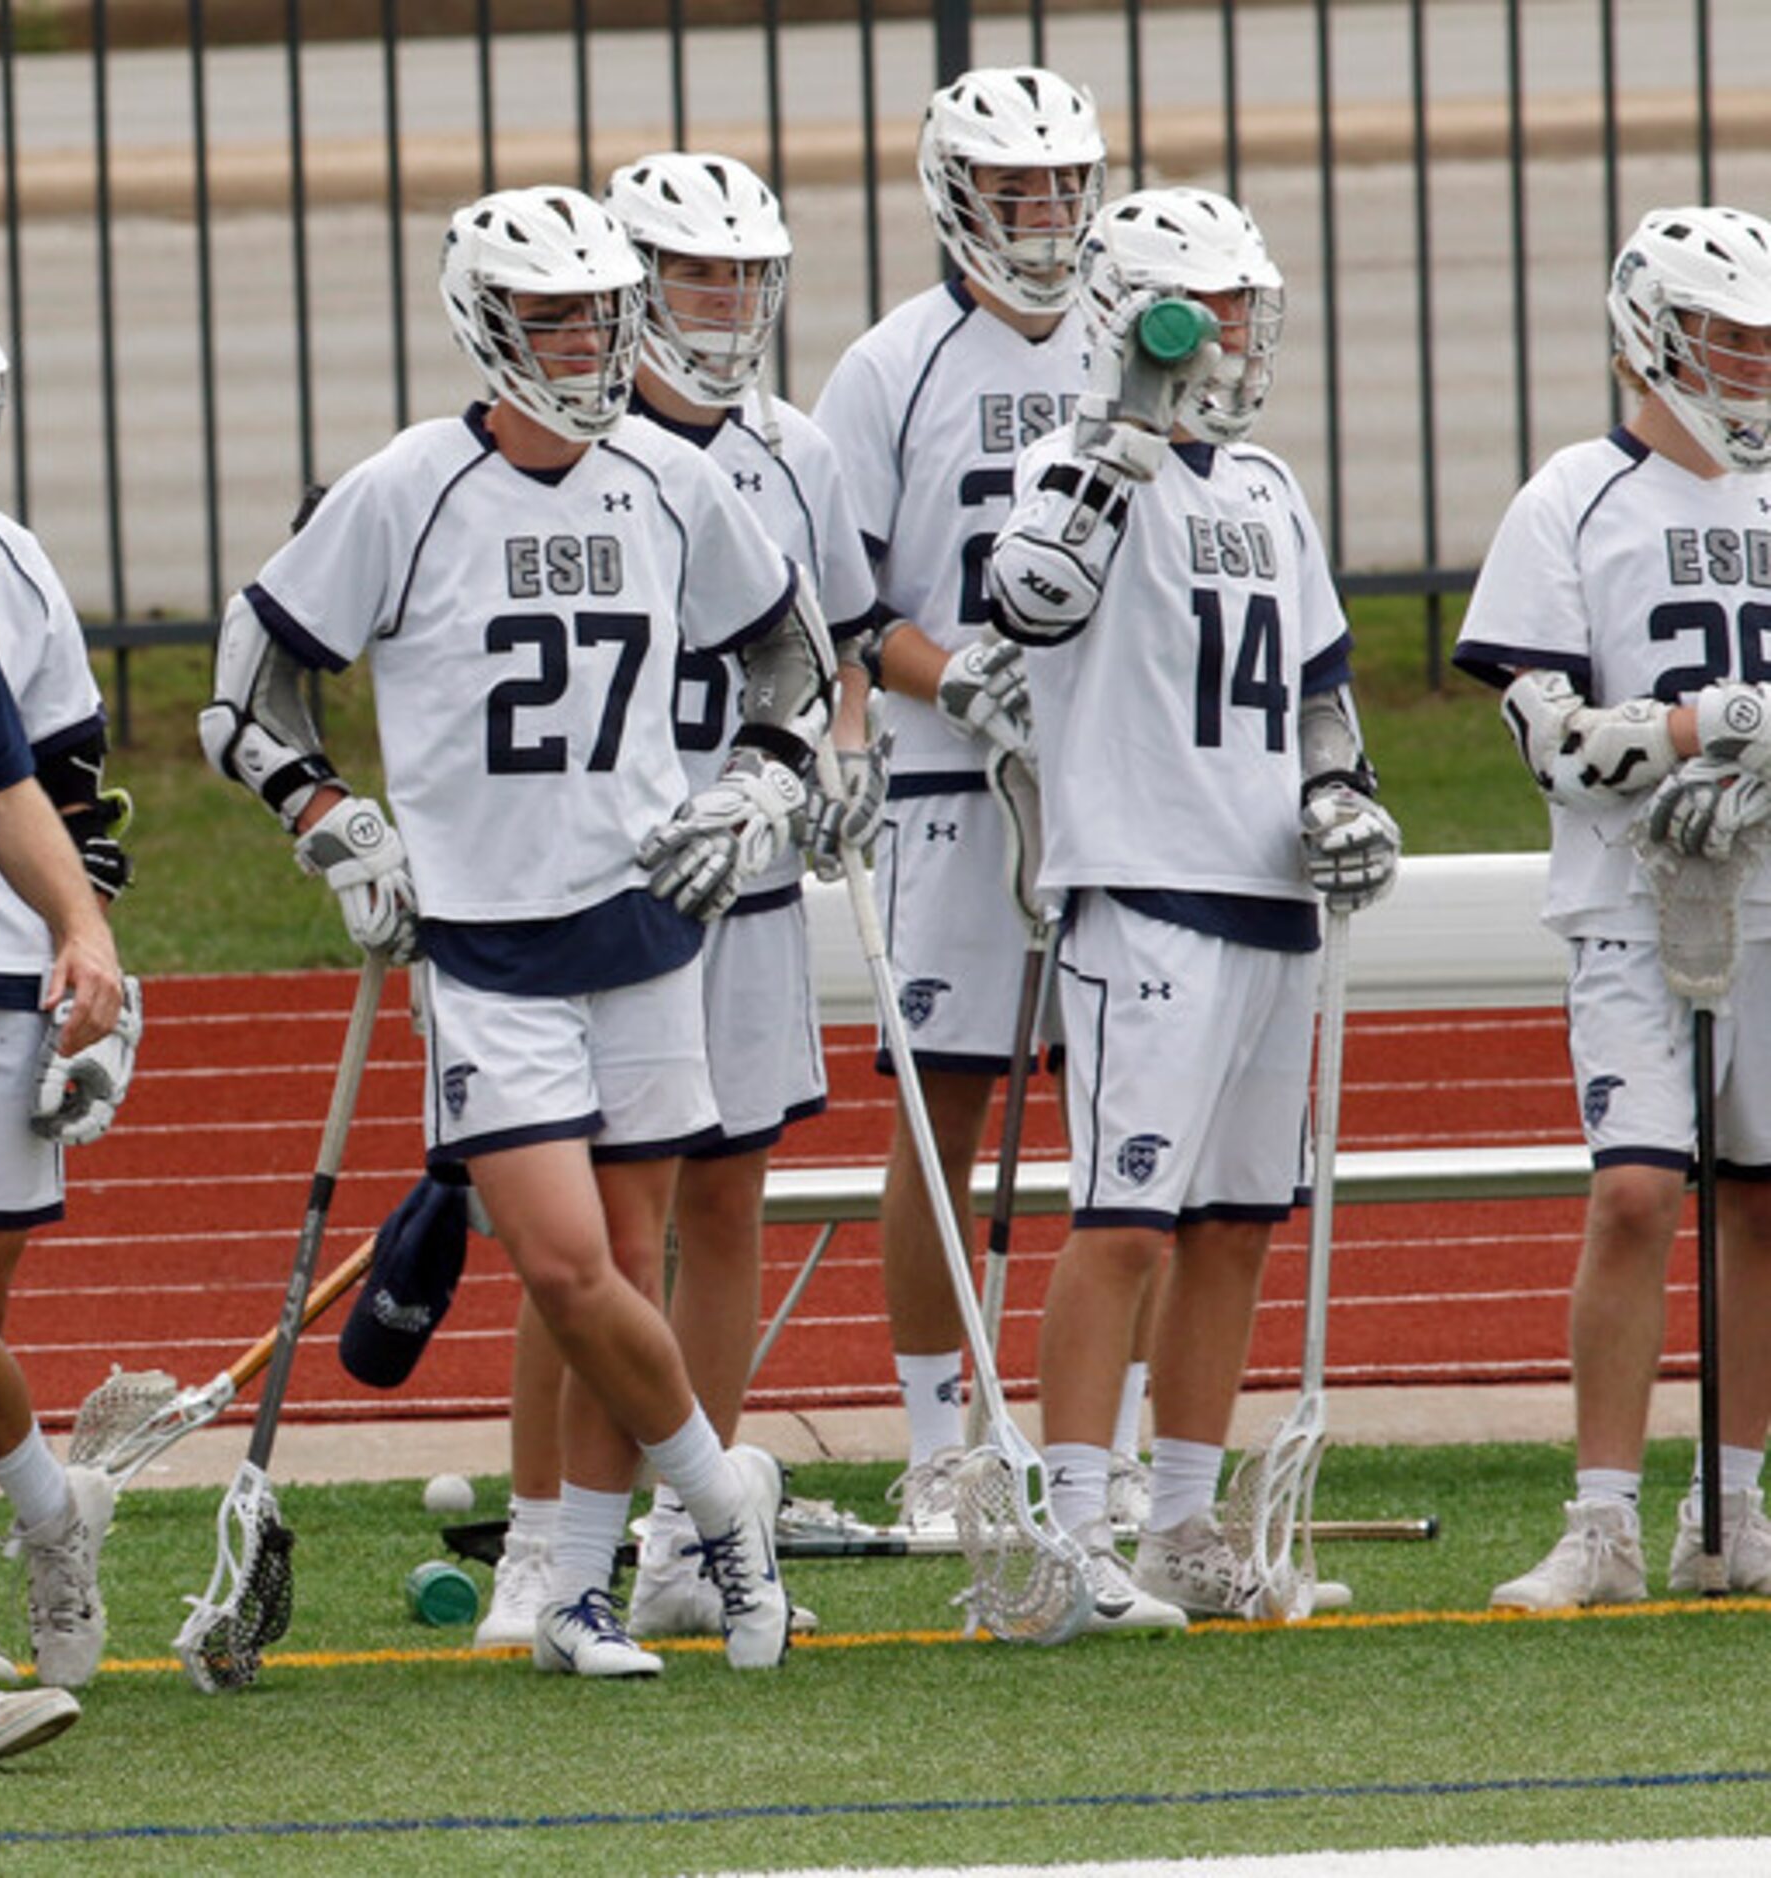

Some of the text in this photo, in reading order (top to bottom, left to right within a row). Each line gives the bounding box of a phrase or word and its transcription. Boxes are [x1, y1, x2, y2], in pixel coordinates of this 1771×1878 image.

[505, 536, 623, 599] ESD
[1187, 514, 1276, 581] ESD
[1665, 528, 1771, 587] ESD
[485, 611, 650, 775] 27
[1191, 588, 1289, 753] 14
